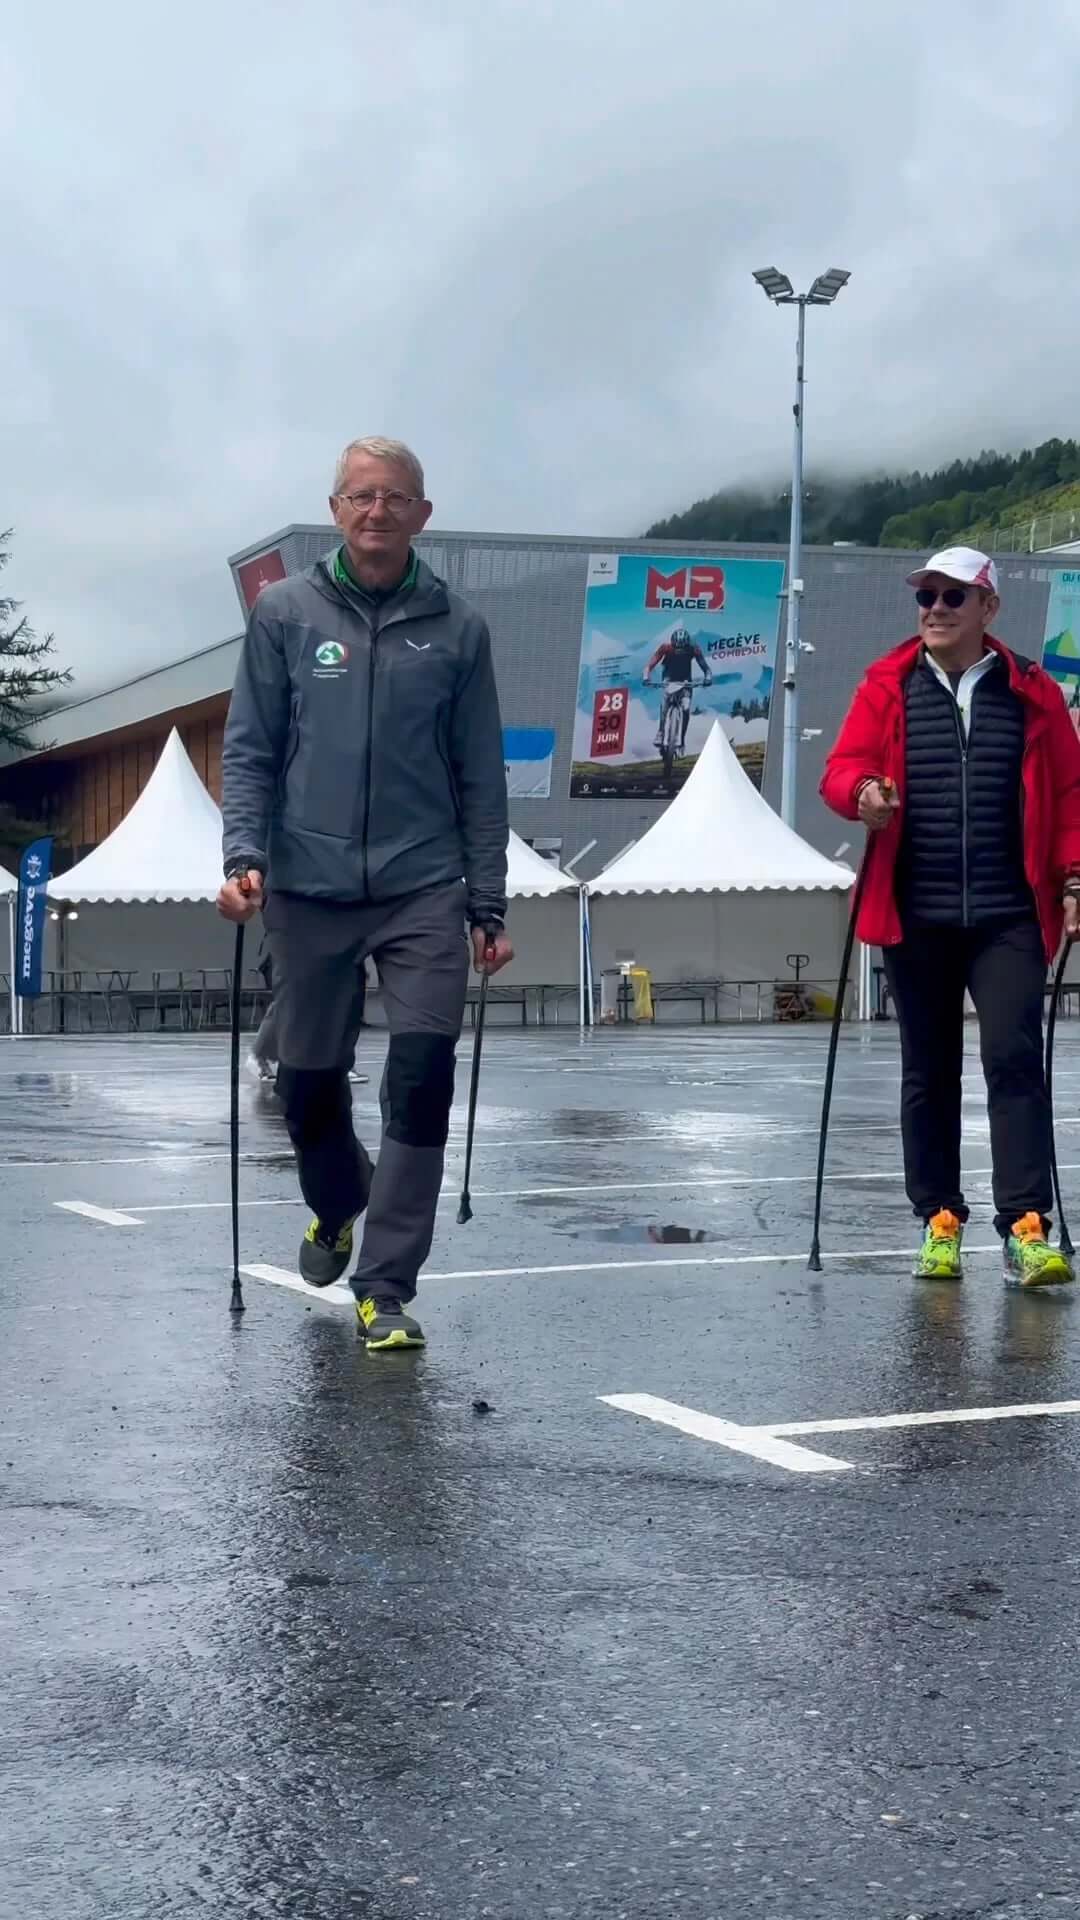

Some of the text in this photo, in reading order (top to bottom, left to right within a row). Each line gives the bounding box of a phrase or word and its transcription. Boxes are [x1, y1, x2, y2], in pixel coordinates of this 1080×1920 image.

[645, 566, 725, 609] MB
[661, 599, 707, 609] RACE
[707, 632, 761, 652] MEGÈVE
[711, 645, 767, 660] COMBLOUX
[599, 693, 623, 712] 28
[597, 714, 621, 733] 30
[597, 732, 620, 744] JUIN
